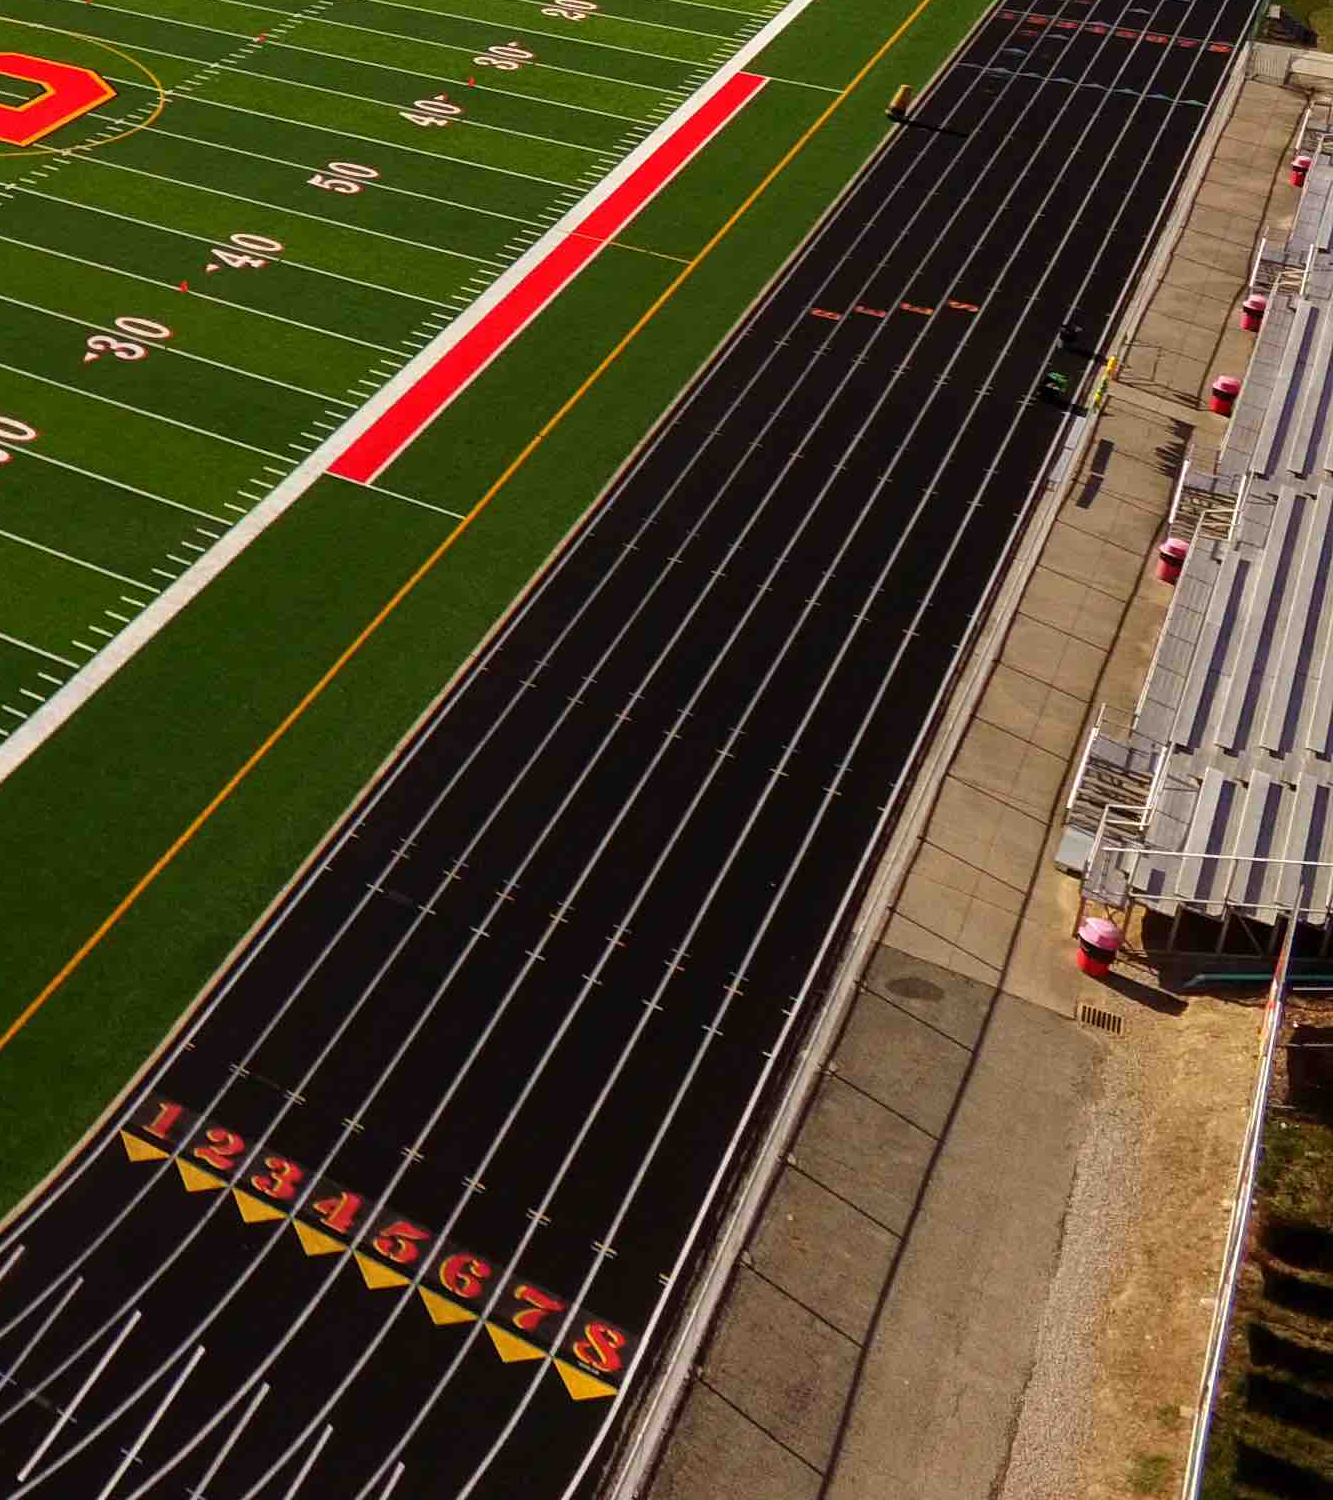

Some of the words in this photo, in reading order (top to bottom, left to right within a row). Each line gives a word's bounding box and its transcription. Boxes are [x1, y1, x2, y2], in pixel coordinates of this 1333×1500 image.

[473, 43, 536, 71] 30
[399, 98, 462, 129] 40
[308, 160, 381, 195] 50
[218, 232, 284, 271] 40
[85, 315, 172, 361] 30
[142, 1101, 184, 1140] 1
[193, 1126, 246, 1171] 2
[250, 1155, 305, 1201] 3
[311, 1190, 364, 1234] 4
[372, 1219, 431, 1265] 5
[438, 1250, 492, 1300] 6
[511, 1283, 566, 1331] 7
[573, 1320, 627, 1374] 8
